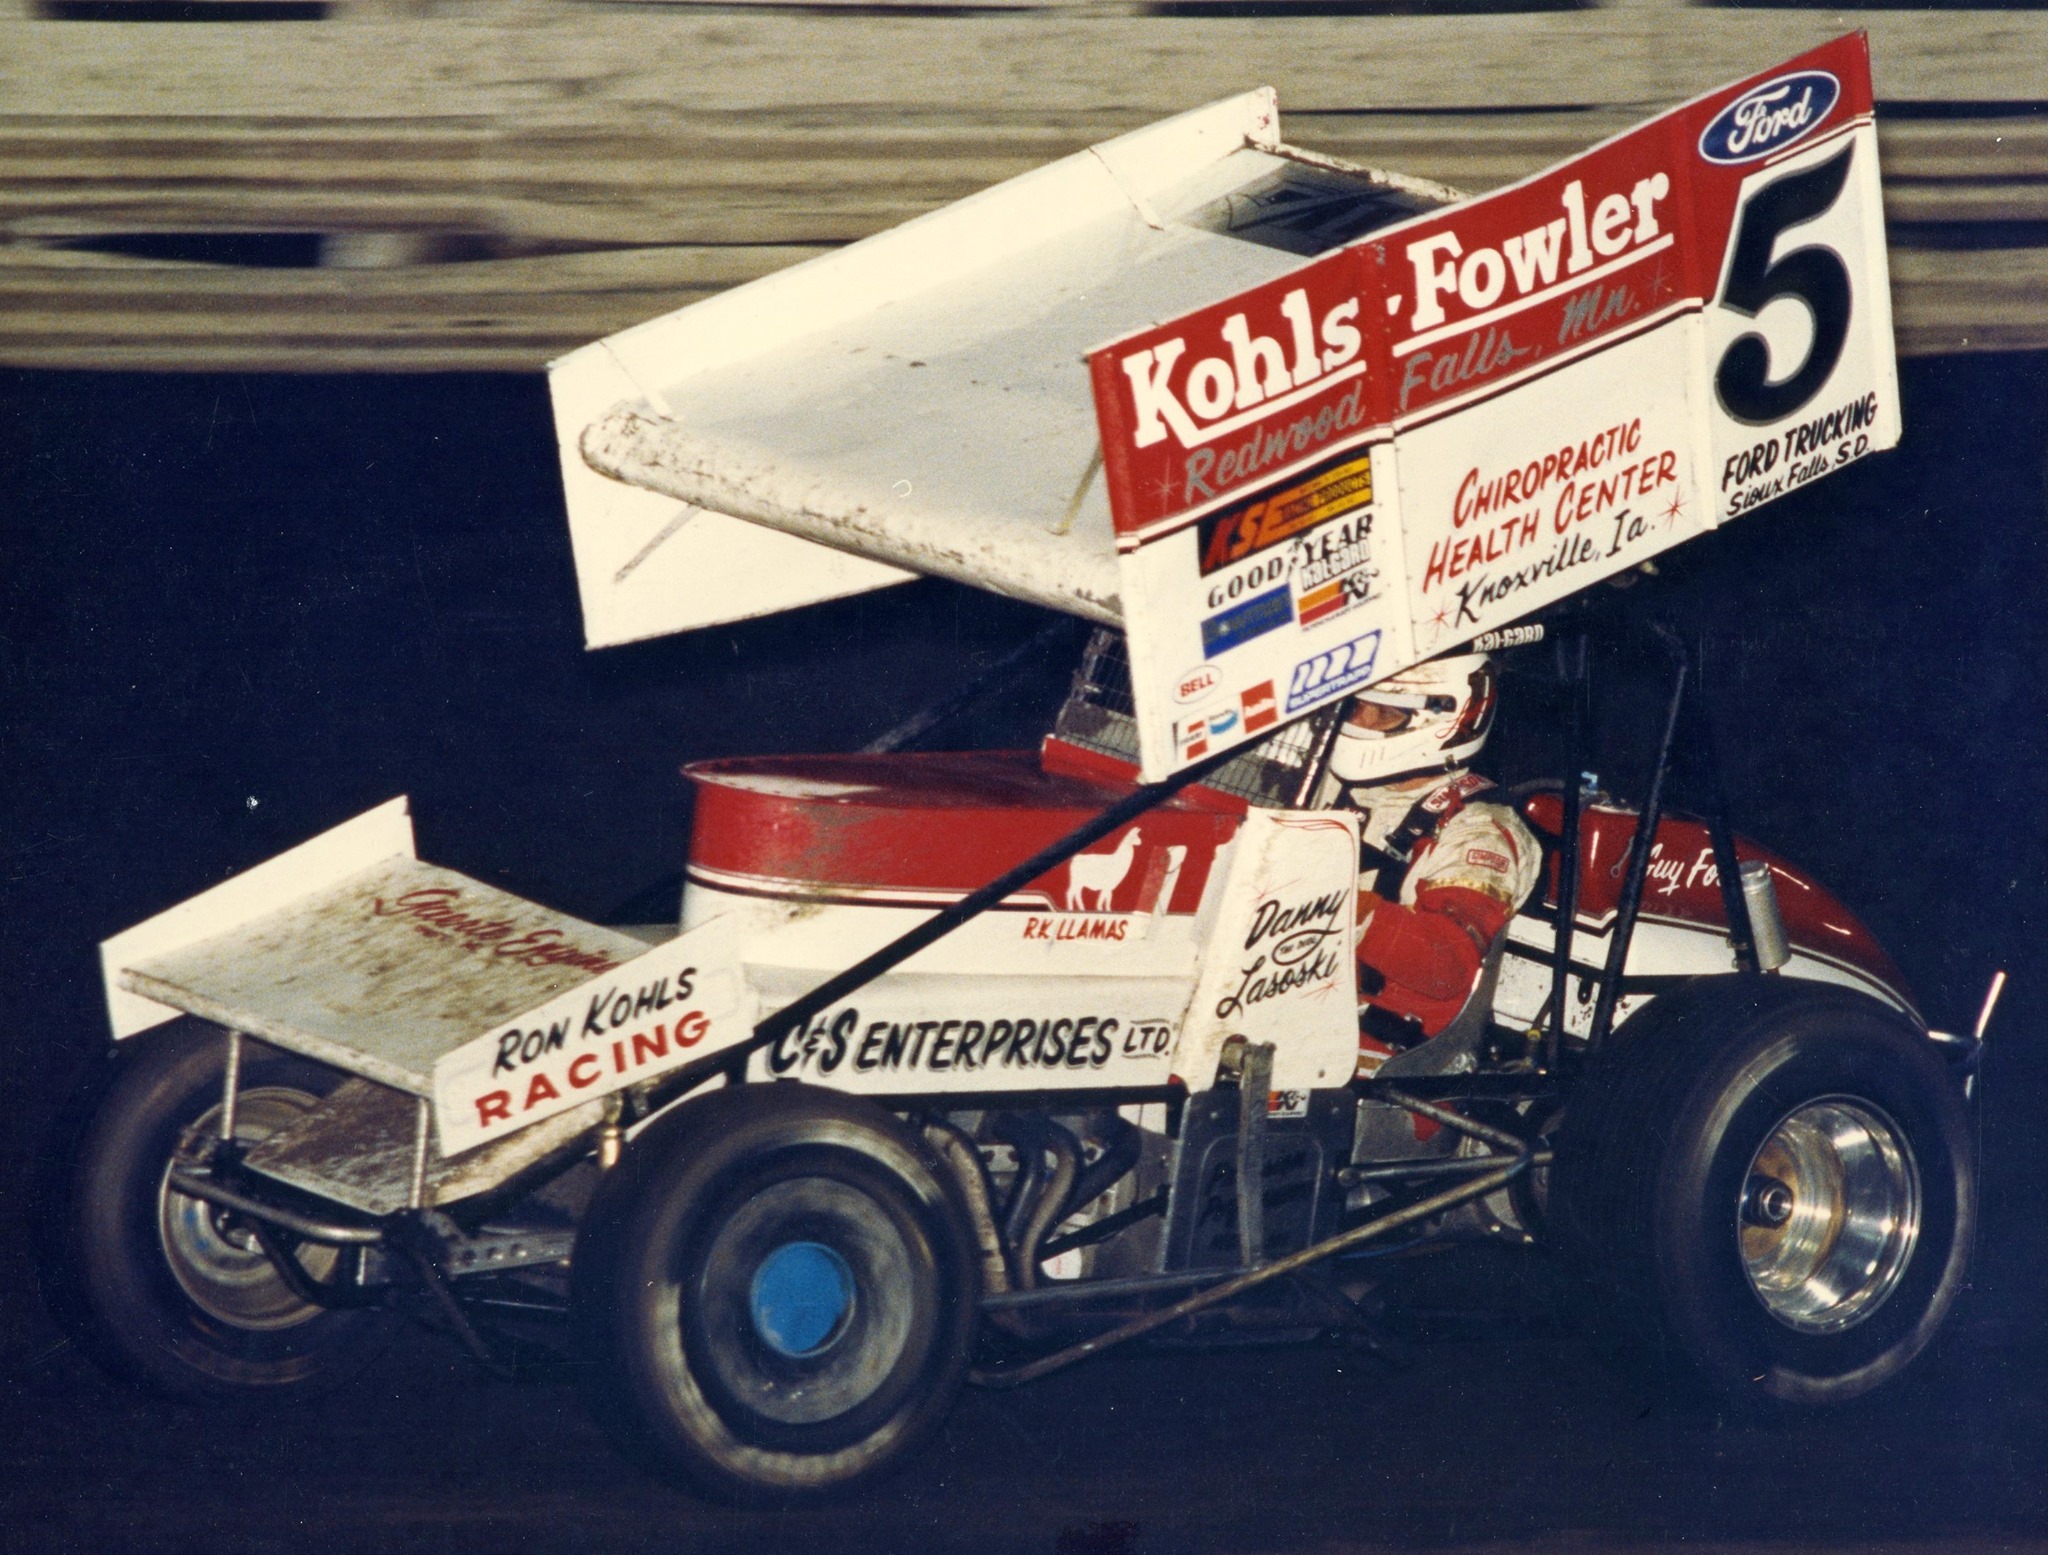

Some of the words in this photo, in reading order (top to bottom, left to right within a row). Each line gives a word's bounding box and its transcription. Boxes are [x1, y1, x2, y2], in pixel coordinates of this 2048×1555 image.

[1728, 83, 1813, 152] Ford
[1122, 288, 1367, 450] Kohls
[1406, 172, 1670, 332] Fowler
[1714, 133, 1857, 428] 5
[1184, 380, 1366, 504] Redwood
[1453, 418, 1642, 529] CHIROPRACTIC
[1722, 438, 1779, 493] FORD
[1784, 391, 1878, 462] TRUCKING
[1422, 509, 1540, 594] HEALTH
[1554, 450, 1678, 534] CENTER
[1726, 476, 1784, 516] Sioux
[1455, 533, 1600, 628] Knoxville,
[1605, 508, 1656, 558] Ia.
[1180, 673, 1214, 698] BELL
[1056, 918, 1128, 941] LLAMAS
[1244, 888, 1350, 951] Danny
[492, 1017, 570, 1078] RON
[582, 967, 697, 1039] KOHLS
[1215, 940, 1342, 1019] Lasoski
[474, 1010, 712, 1128] RACING
[854, 1016, 1122, 1073] ENTERPRISES
[1122, 1026, 1171, 1056] LTD.
